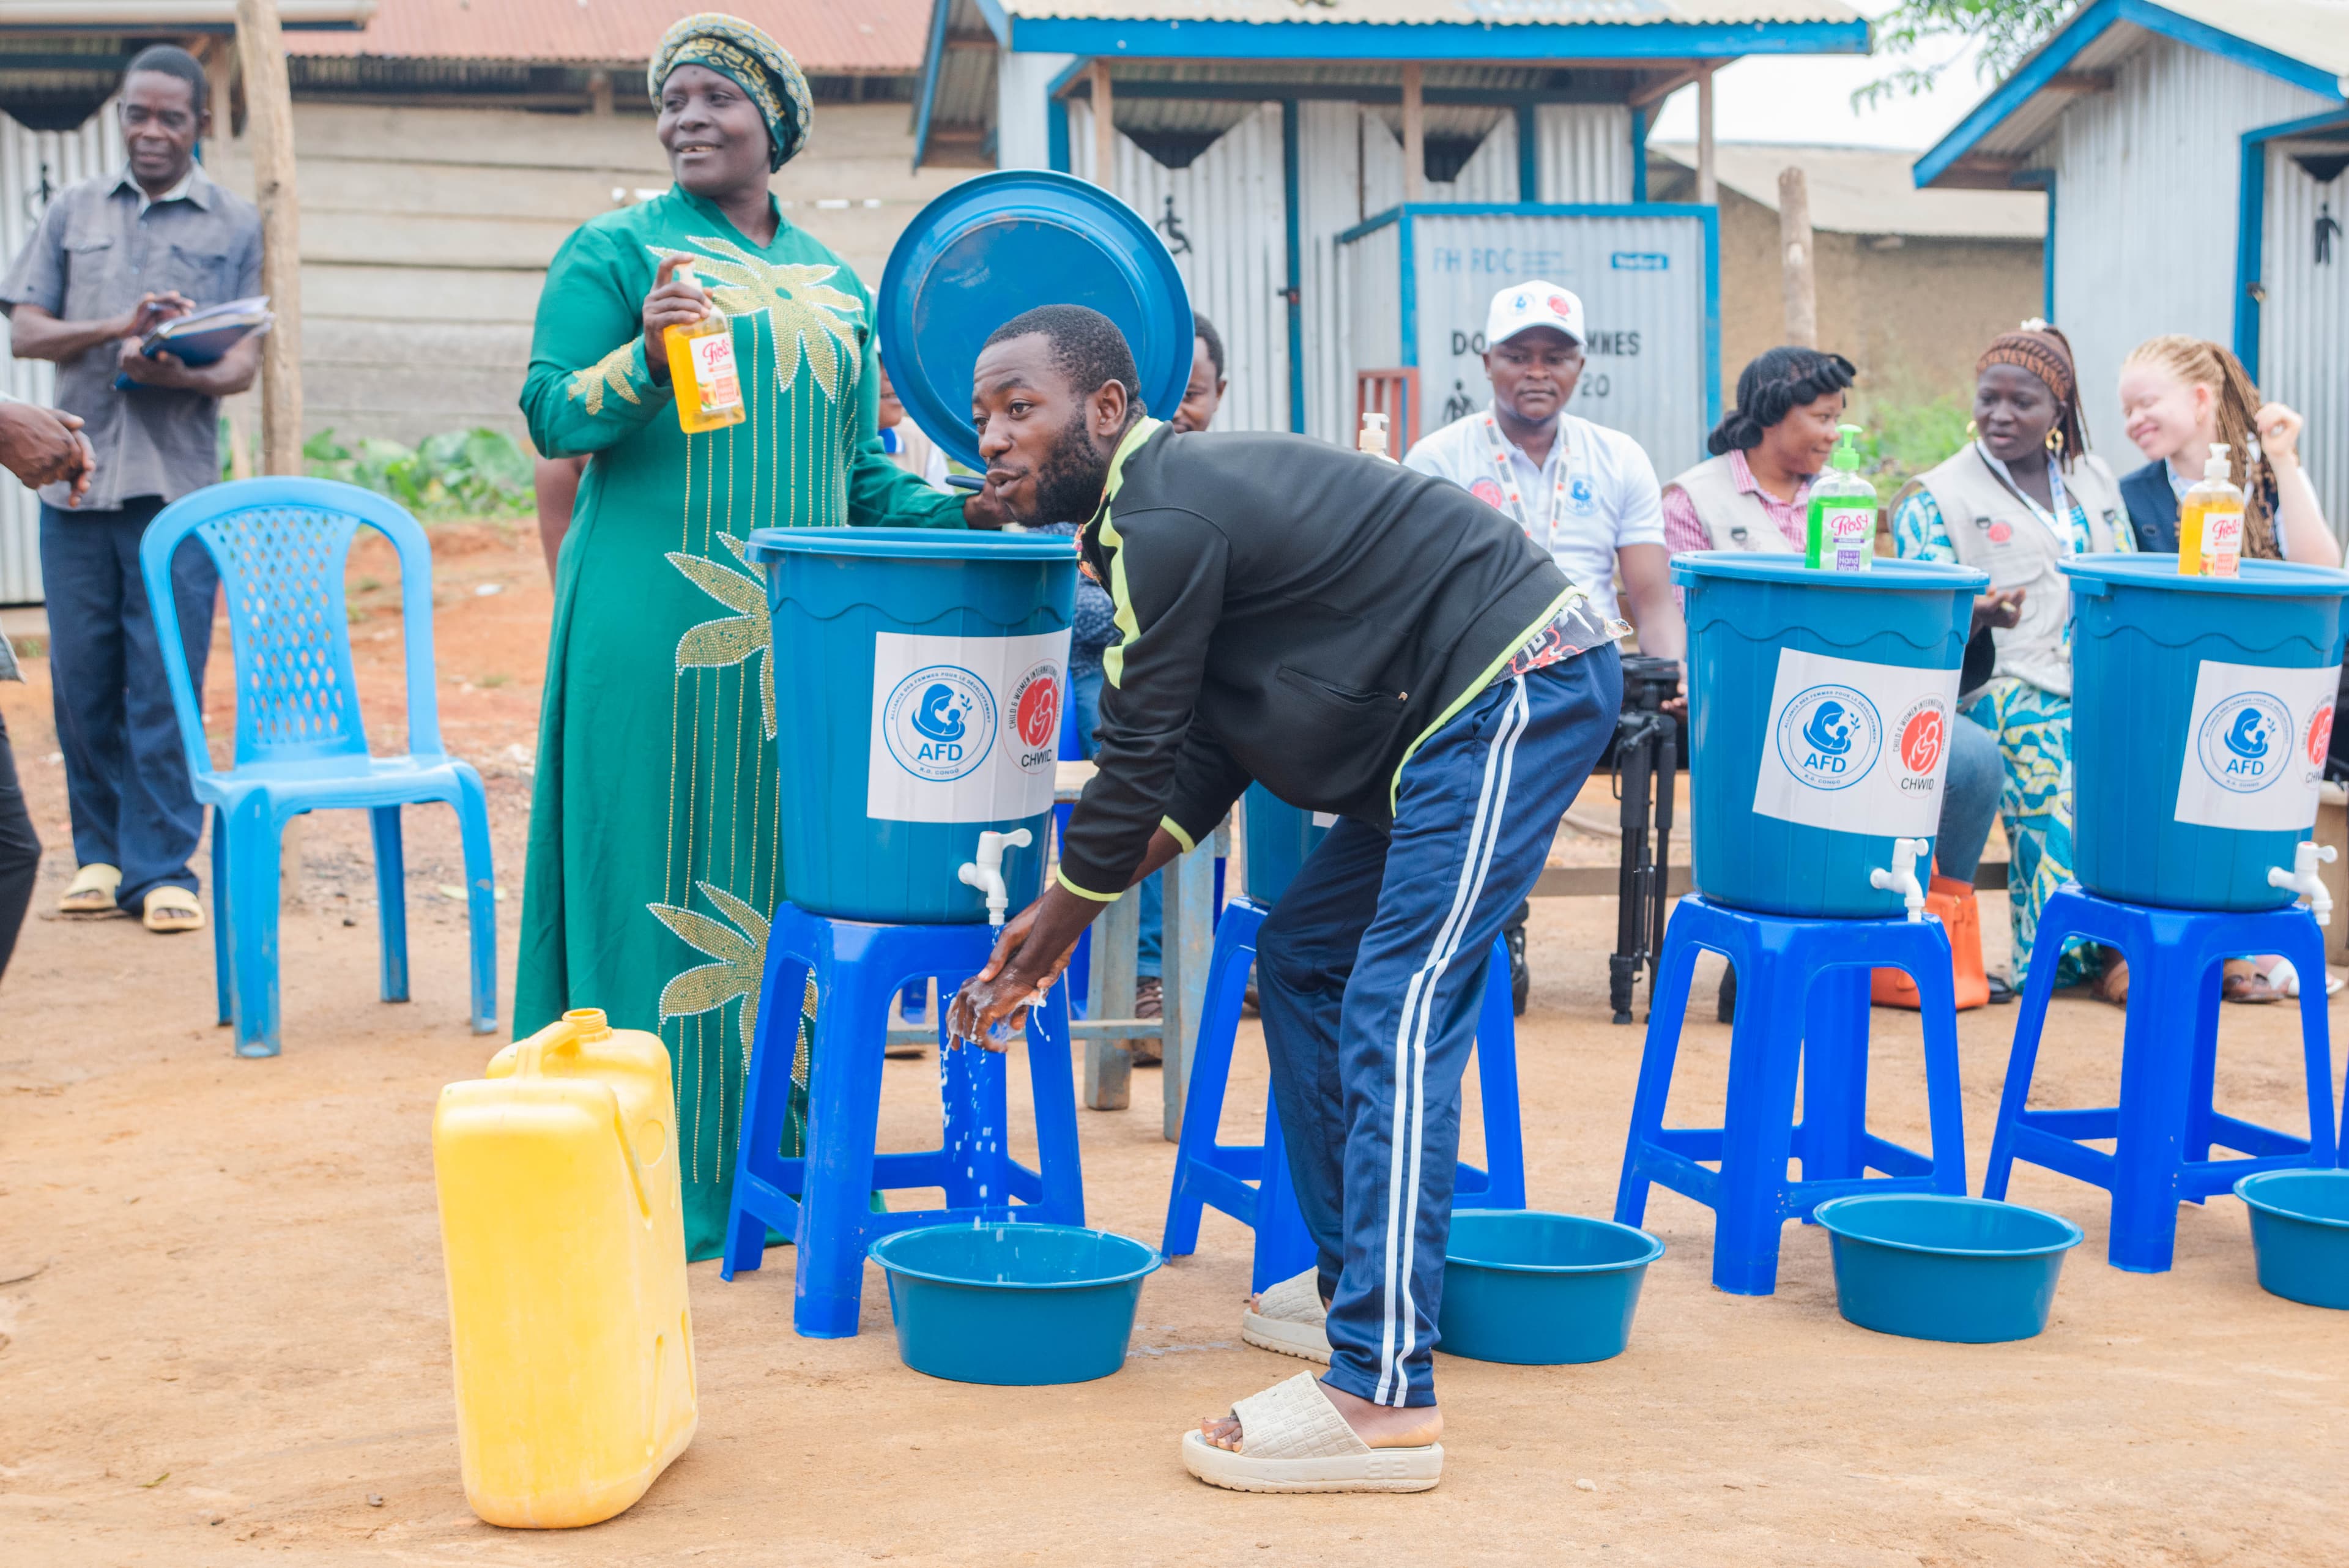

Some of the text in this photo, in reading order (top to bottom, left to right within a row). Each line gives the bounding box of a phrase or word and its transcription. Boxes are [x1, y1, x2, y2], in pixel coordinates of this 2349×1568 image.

[914, 672, 938, 683] FEMMES
[1013, 675, 1030, 700] WOMEN
[1893, 732, 1901, 752] CHILD
[1899, 705, 1917, 726] WOMEN
[918, 743, 963, 761] AFD
[1804, 752, 1846, 773] AFD
[2226, 759, 2264, 775] AFD
[1901, 778, 1934, 790] CHWID
